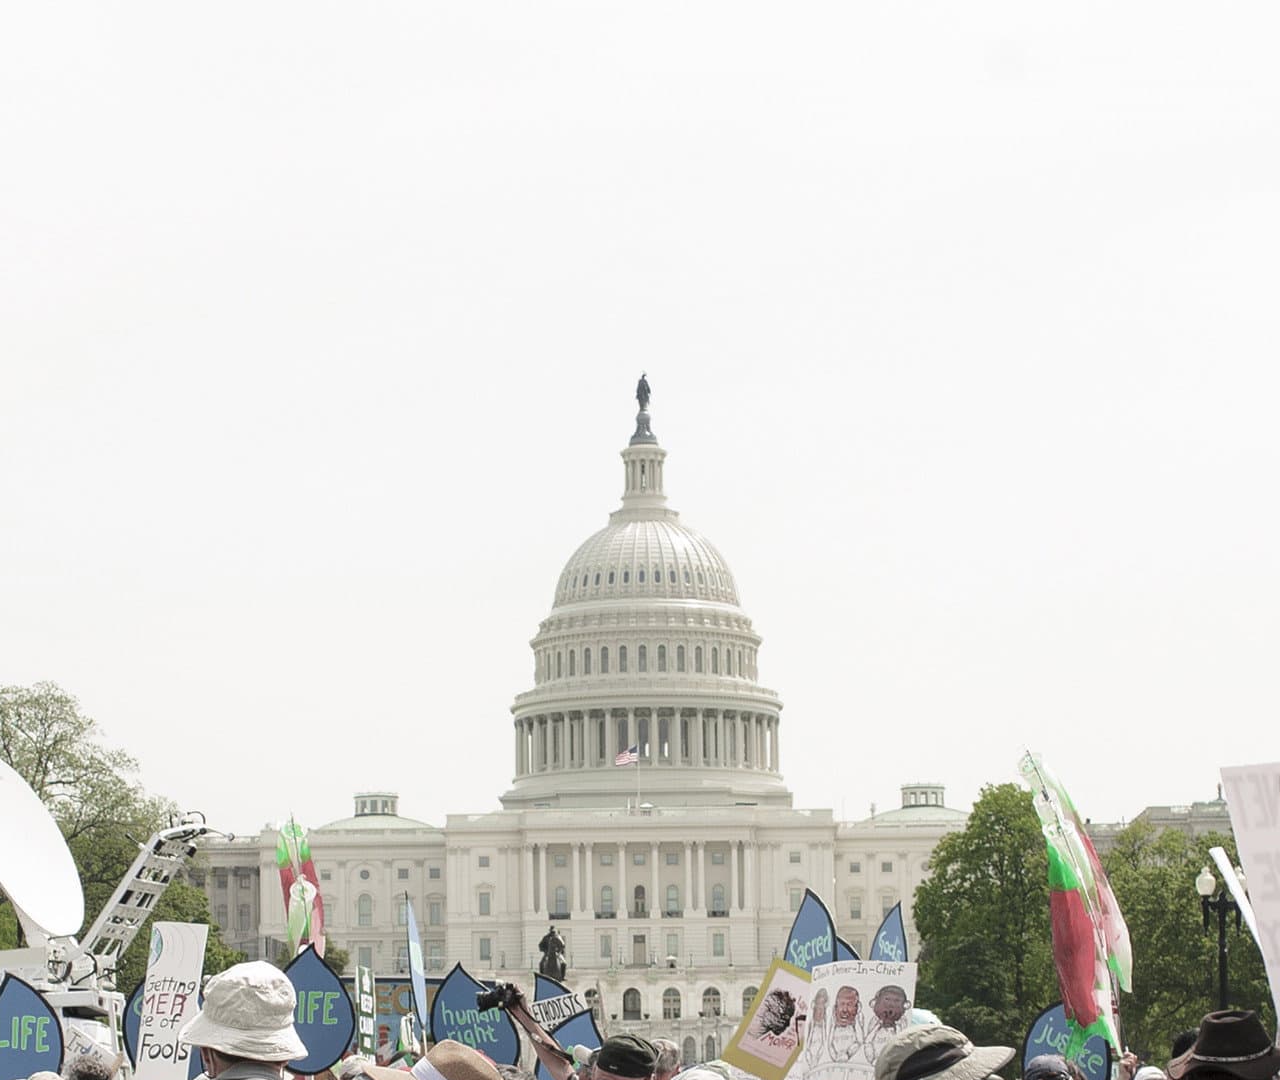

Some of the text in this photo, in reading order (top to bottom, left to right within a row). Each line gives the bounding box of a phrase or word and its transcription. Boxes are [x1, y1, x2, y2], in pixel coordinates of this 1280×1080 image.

[297, 990, 341, 1025] IFE
[441, 1000, 501, 1026] human
[532, 993, 585, 1023] ETHODISTS
[140, 1033, 189, 1064] Fools
